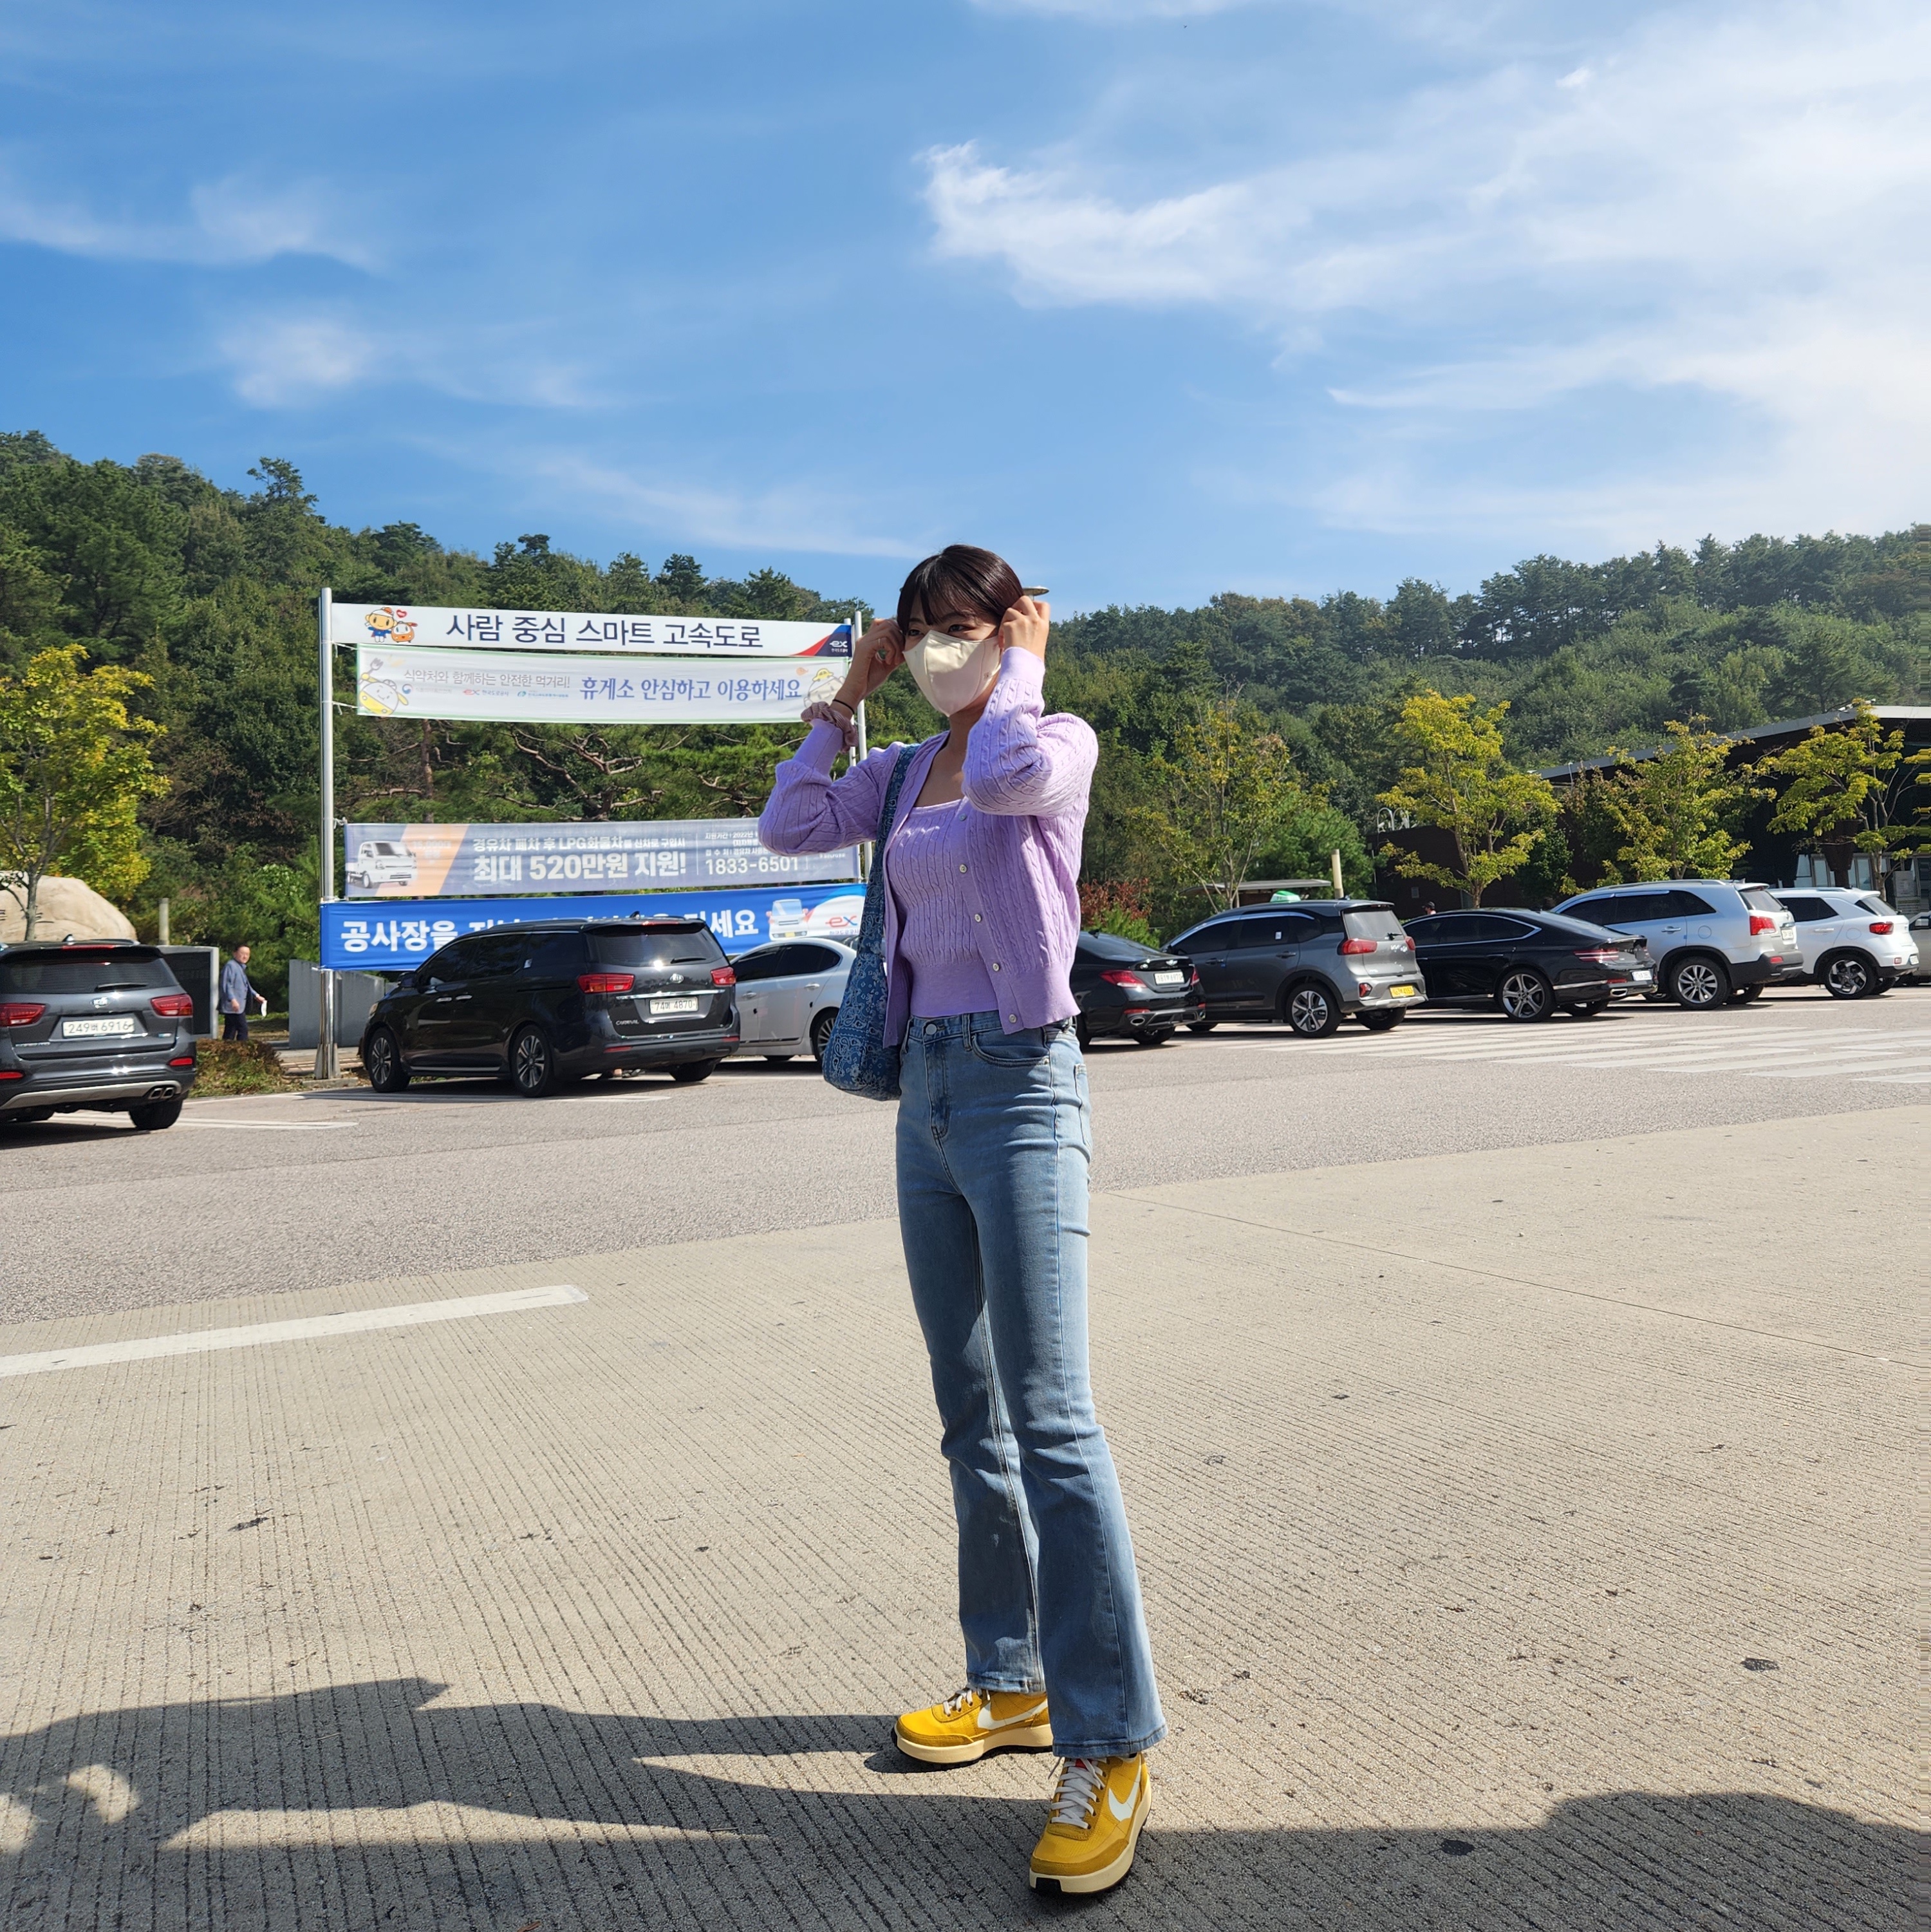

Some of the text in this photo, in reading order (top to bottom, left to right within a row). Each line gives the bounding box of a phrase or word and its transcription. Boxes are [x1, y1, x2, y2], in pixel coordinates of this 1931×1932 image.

[446, 614, 764, 649] 사람 중심 스마트 고속도로
[404, 669, 570, 688] 식약처와 함께하는 안전한 먹거리!
[580, 677, 802, 702] 휴게소 안심하고 이용하세요
[473, 838, 512, 852] 경유차
[515, 838, 541, 851] 폐차
[543, 838, 556, 851] 후
[635, 838, 659, 849] 신차로
[661, 838, 686, 848] 구입시
[474, 850, 686, 882] 최대 520만원 지원!
[705, 856, 798, 875] 1833-6501
[825, 915, 858, 928] ex
[341, 920, 458, 953] 공사장을
[673, 1000, 693, 1009] 4870
[101, 1021, 129, 1031] 6916
